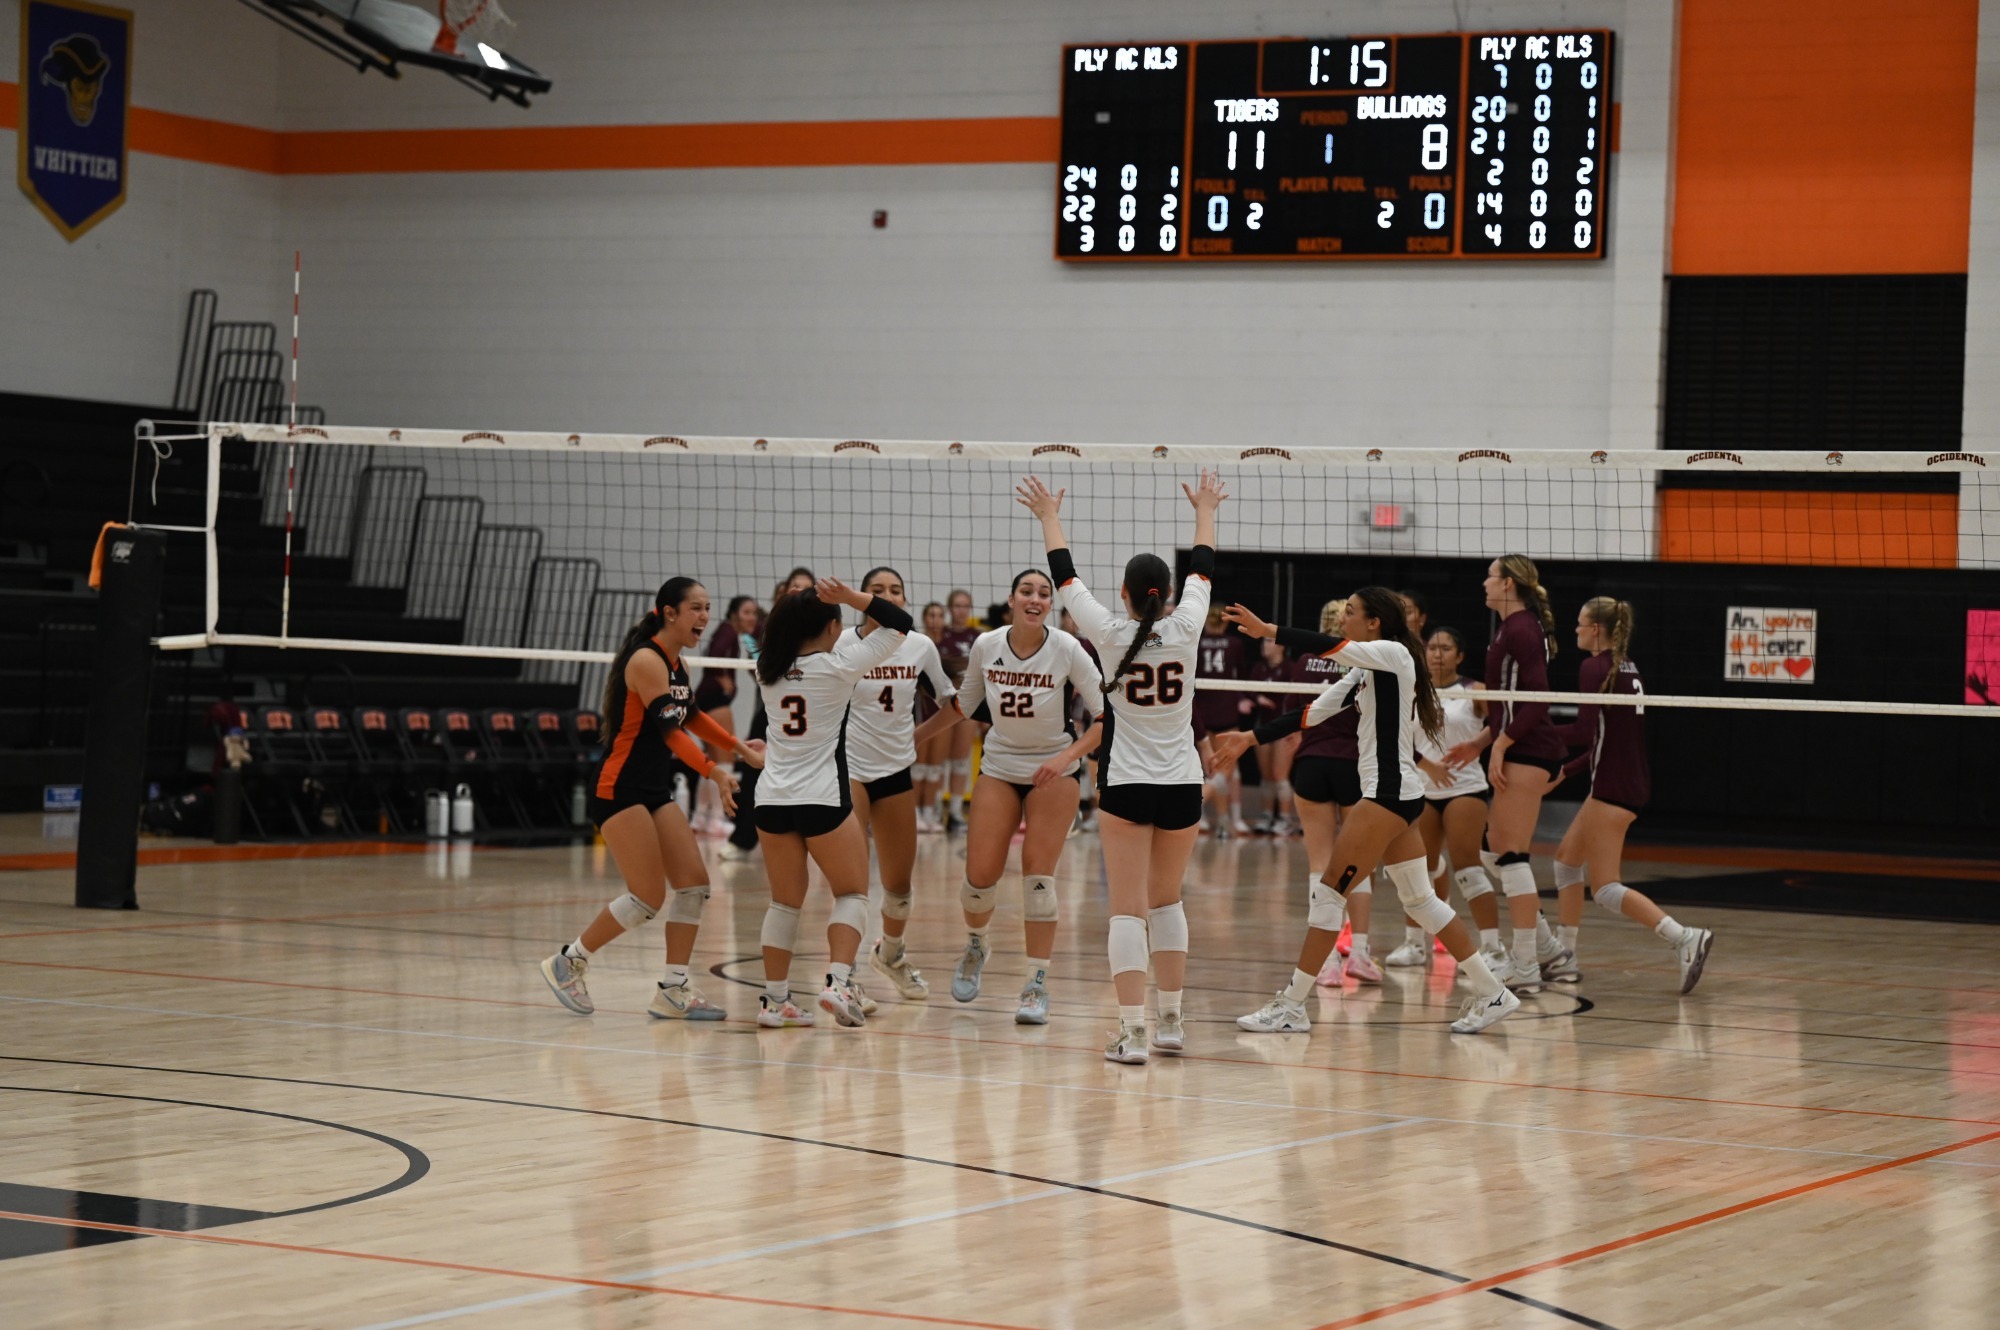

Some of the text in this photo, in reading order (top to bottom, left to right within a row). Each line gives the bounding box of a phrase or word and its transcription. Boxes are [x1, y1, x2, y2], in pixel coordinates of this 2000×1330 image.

[1074, 46, 1178, 72] PLY AC KLS
[1481, 35, 1593, 61] PLY AC KLS
[1494, 61, 1597, 90] 7 0 0
[1214, 98, 1280, 123] TIGERS
[1357, 94, 1447, 120] BULLDOGS
[1472, 94, 1597, 123] 20 0 1
[1227, 130, 1266, 171] 11
[1324, 133, 1334, 165] 1
[1421, 124, 1449, 170] 8
[1471, 126, 1596, 155] 21 0 1
[34, 145, 118, 181] WHITTIER
[1486, 157, 1594, 186] 2 0 2
[1063, 163, 1179, 192] 24 0 1
[1195, 179, 1236, 195] FOULS
[1279, 177, 1366, 192] PLAYER FOUL
[1409, 175, 1453, 191] FOULS
[1063, 193, 1178, 222] 22 0 2
[1207, 195, 1264, 232] 0 2
[1377, 193, 1446, 230] 2 0
[1477, 189, 1592, 217] 14 0 0
[1079, 224, 1177, 253] 3 0 0
[1297, 237, 1343, 253] MATCH
[1485, 220, 1591, 249] 4 0 0
[461, 430, 505, 445] OCCIDENTAL
[643, 436, 689, 450] OCCIDENTAL
[833, 440, 881, 455] OCCIDENTAL
[1032, 444, 1082, 458] OCCIDENTAL
[1239, 447, 1292, 461] OCCIDENTAL
[1457, 449, 1512, 464] OCCIDENTAL
[1686, 451, 1743, 466] OCCIDENTAL
[1926, 452, 1986, 467] OCCIDENTAL
[1204, 650, 1226, 673] 14
[1749, 660, 1781, 677] our
[987, 669, 1055, 689] OCCIDENTAL
[1125, 661, 1184, 707] 26
[878, 685, 894, 713] 4
[1000, 691, 1035, 718] 22
[780, 694, 809, 737] 3
